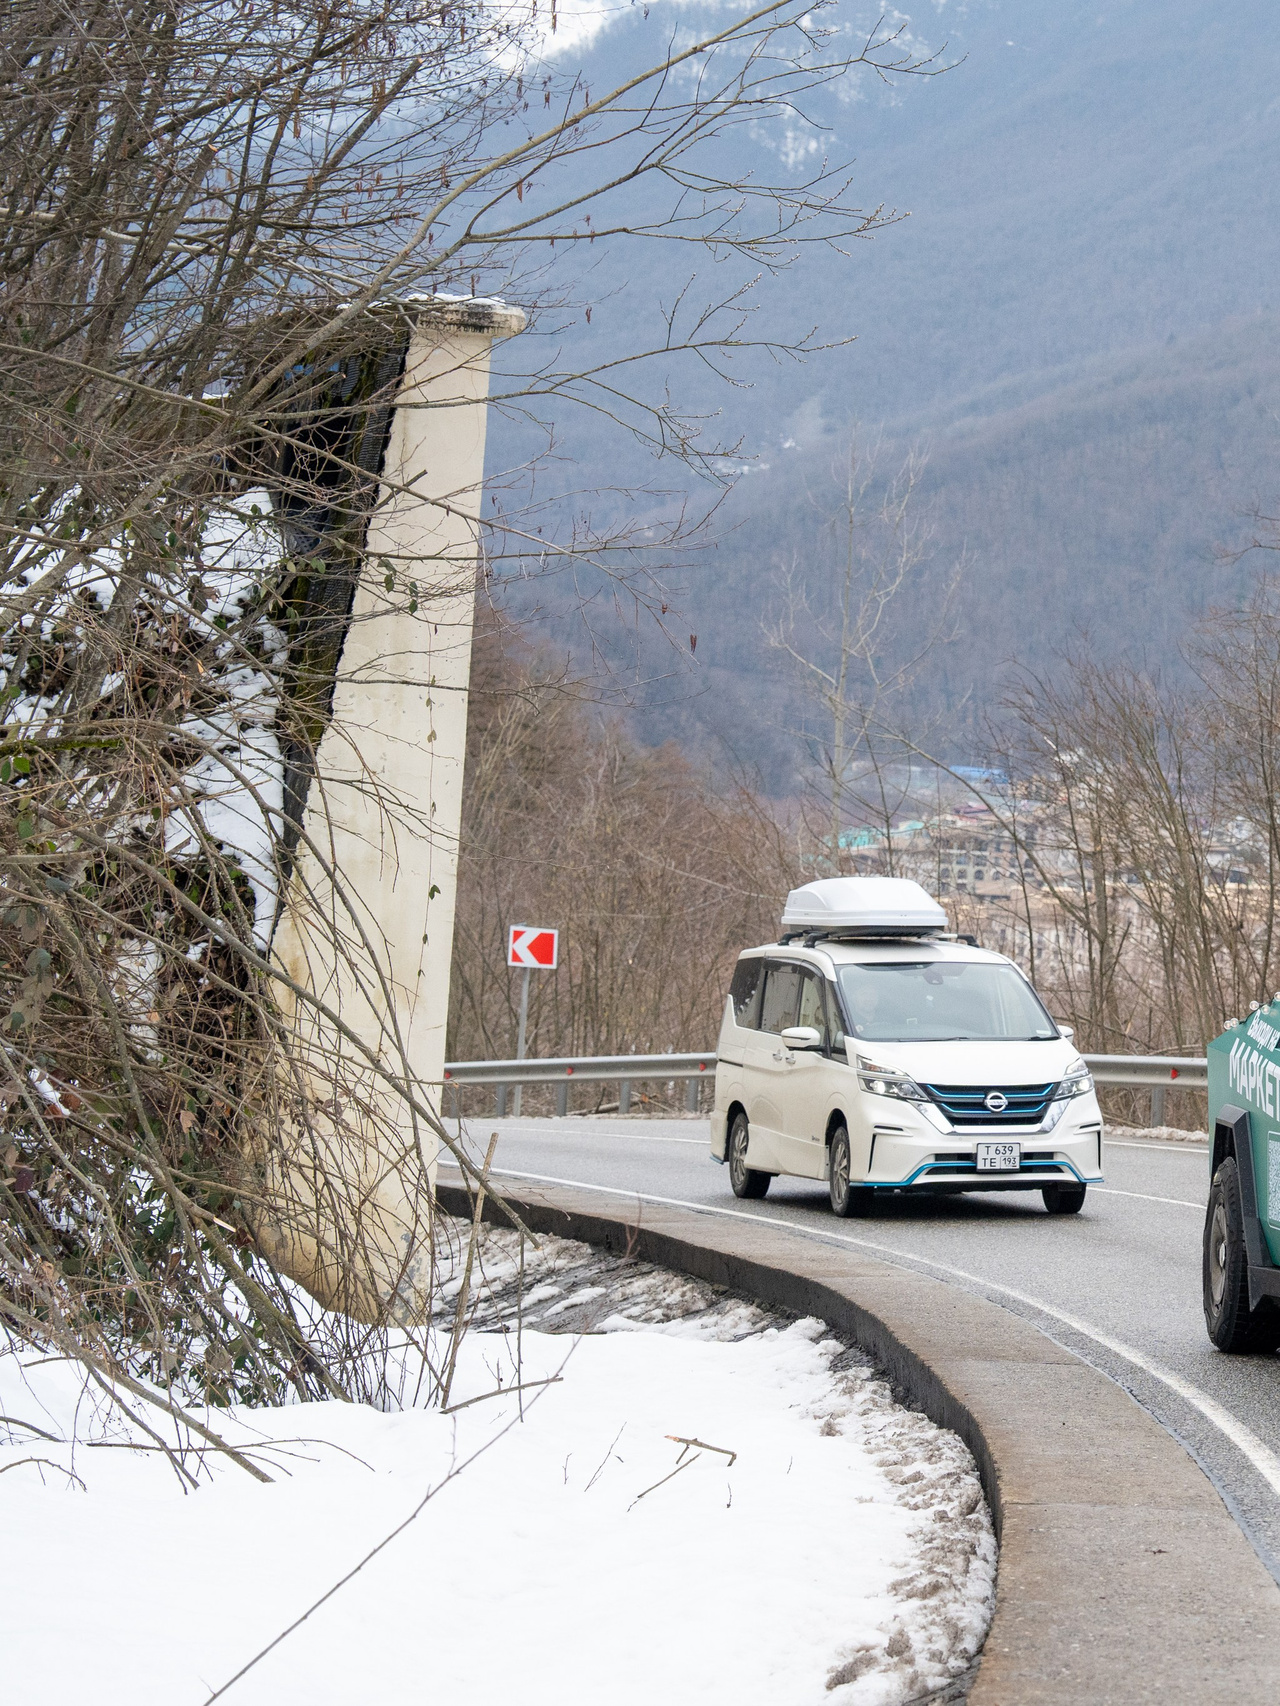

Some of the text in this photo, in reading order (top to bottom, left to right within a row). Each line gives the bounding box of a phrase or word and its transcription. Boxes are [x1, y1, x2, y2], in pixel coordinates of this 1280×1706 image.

[995, 1146, 1014, 1155] 639
[982, 1158, 997, 1167] ТЕ
[1002, 1157, 1017, 1165] 193
